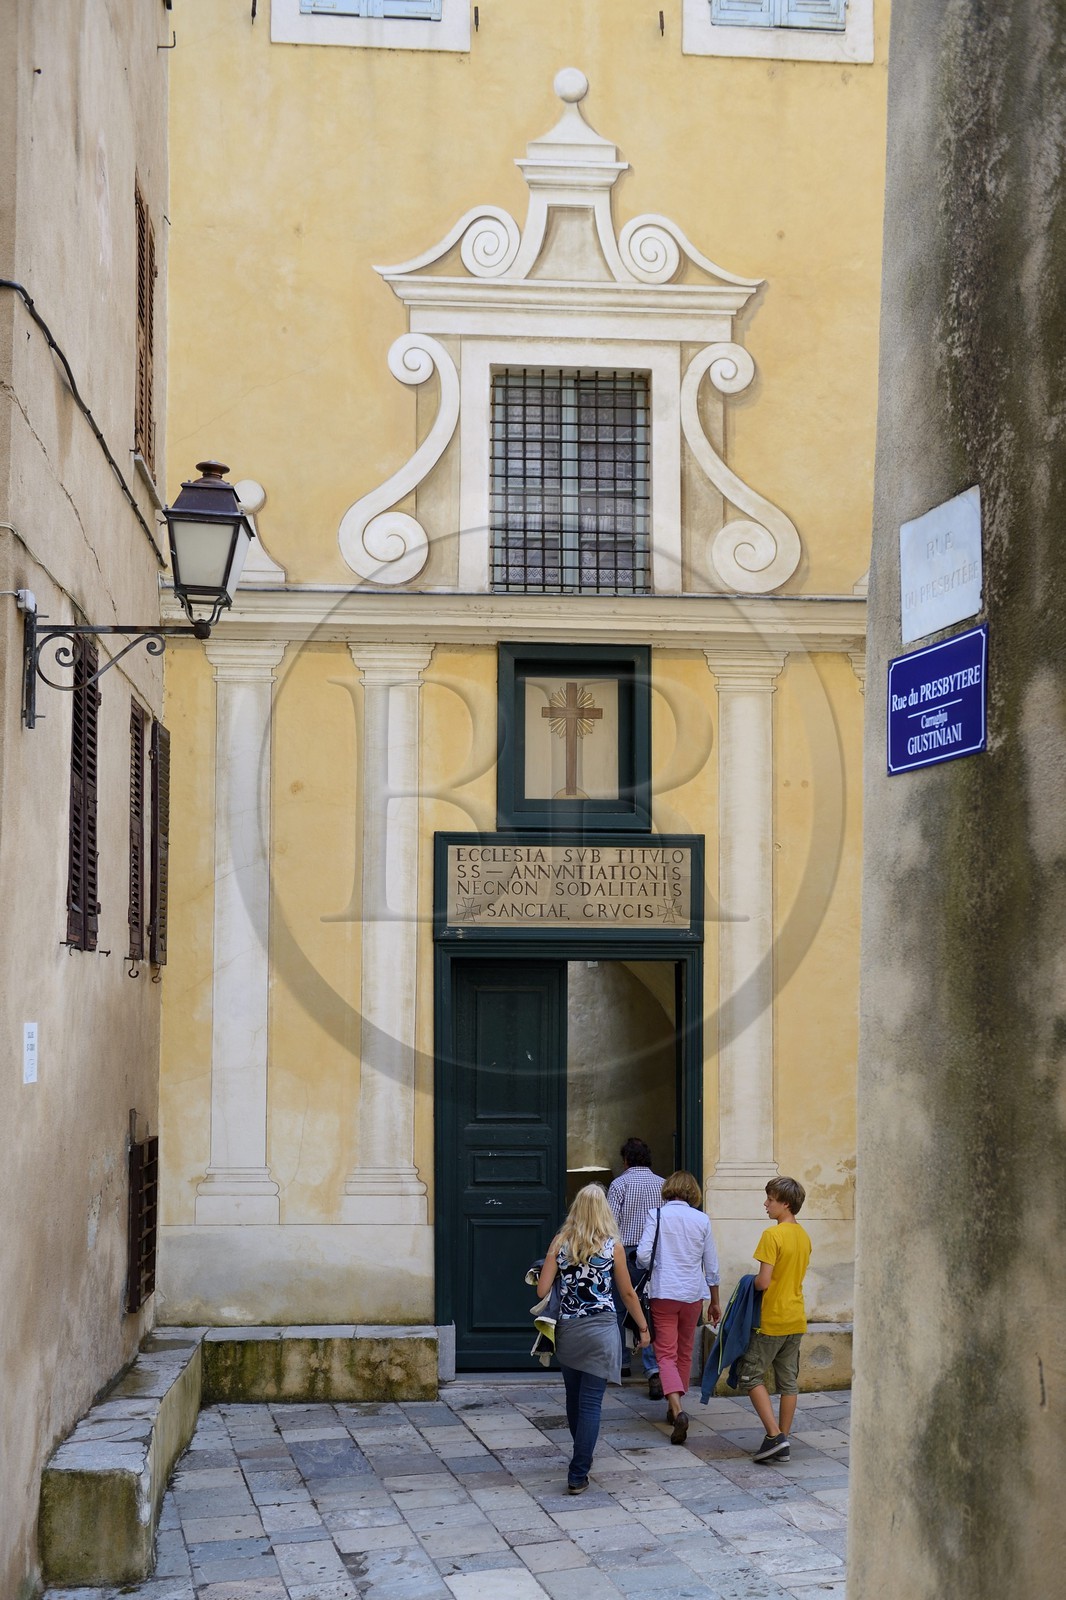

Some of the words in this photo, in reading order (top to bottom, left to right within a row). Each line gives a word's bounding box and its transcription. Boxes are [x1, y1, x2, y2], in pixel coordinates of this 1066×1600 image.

[926, 530, 954, 560] RUE
[891, 694, 907, 713] Rue
[908, 687, 919, 707] du
[919, 664, 981, 703] PRESBYTERE
[907, 722, 963, 756] GIUSTINIANI
[456, 848, 546, 863] ECCLESIA
[563, 849, 601, 864] SVB
[618, 849, 684, 865] TITVLO
[456, 864, 481, 879] SS
[510, 865, 682, 881] ANNVNTIATIONIS
[456, 880, 539, 896] NECNON
[555, 881, 683, 897] SODALITATIS
[582, 903, 655, 919] CRVCIS
